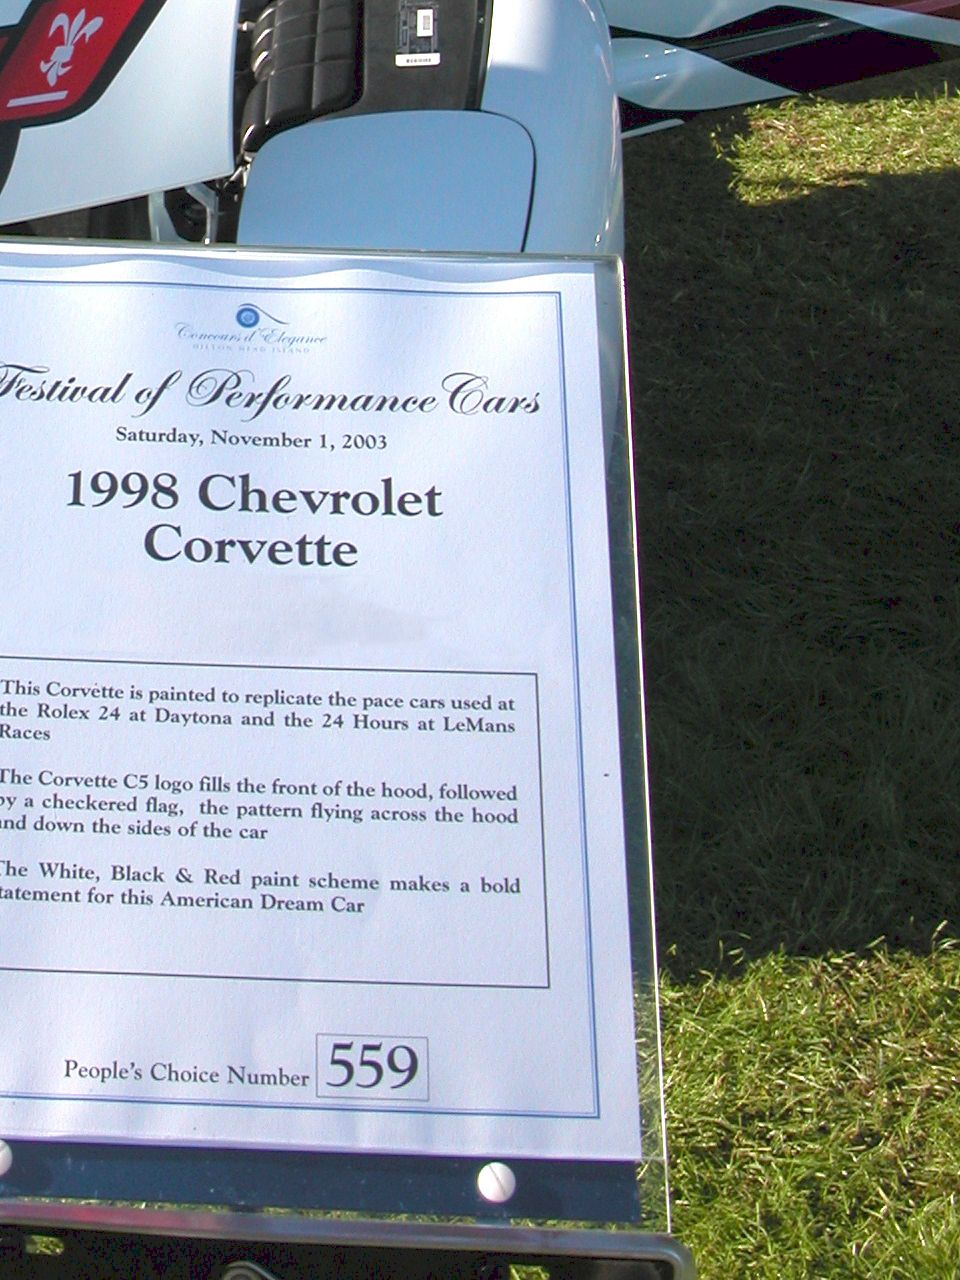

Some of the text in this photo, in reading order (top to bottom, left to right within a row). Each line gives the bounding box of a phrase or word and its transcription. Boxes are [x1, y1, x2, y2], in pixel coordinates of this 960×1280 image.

[131, 369, 183, 419] of
[185, 368, 439, 423] Performance
[441, 372, 541, 416] Cars
[116, 426, 388, 452] Saturday, November 1, 2003
[66, 470, 444, 518] 1998 Chevrolet
[143, 523, 359, 568] Corvette
[0, 678, 516, 712] This Corvette is painted to replicate the pace cars used at
[0, 702, 516, 734] the Rolex 24 at Daytona and the 24 Hours at LeMans
[38, 770, 118, 789] Corvette
[123, 773, 149, 790] C5
[154, 774, 194, 795] logo
[199, 775, 231, 793] fills
[236, 777, 267, 794] the
[271, 777, 317, 795] front
[322, 779, 343, 797] of
[345, 780, 376, 798] the
[381, 781, 433, 801] hood,
[439, 783, 518, 801] followed
[24, 799, 34, 811] a
[41, 792, 138, 811] checkered
[146, 796, 184, 817] flag,
[199, 797, 229, 814] the
[236, 802, 303, 822] pattern
[311, 802, 364, 825] flying
[370, 809, 427, 822] across
[434, 805, 464, 823] the
[471, 805, 518, 824] hood
[32, 814, 85, 833] down
[91, 817, 122, 835] the
[127, 819, 172, 837] sides
[177, 820, 199, 838] of
[202, 821, 233, 839] the
[238, 828, 269, 840] car
[38, 862, 100, 884] White,
[110, 864, 165, 883] Black
[175, 867, 194, 884] &
[204, 868, 241, 886] Red
[250, 870, 300, 890] paint
[308, 871, 380, 891] scheme
[389, 874, 450, 893] makes
[459, 881, 470, 893] a
[480, 876, 521, 894] bold
[87, 887, 115, 905] for
[120, 888, 154, 906] this
[160, 890, 254, 910] American
[260, 893, 324, 912] Dream
[330, 895, 366, 913] Car
[149, 1062, 220, 1084] Choice
[226, 1065, 310, 1087] Number
[325, 1040, 420, 1090] 559
